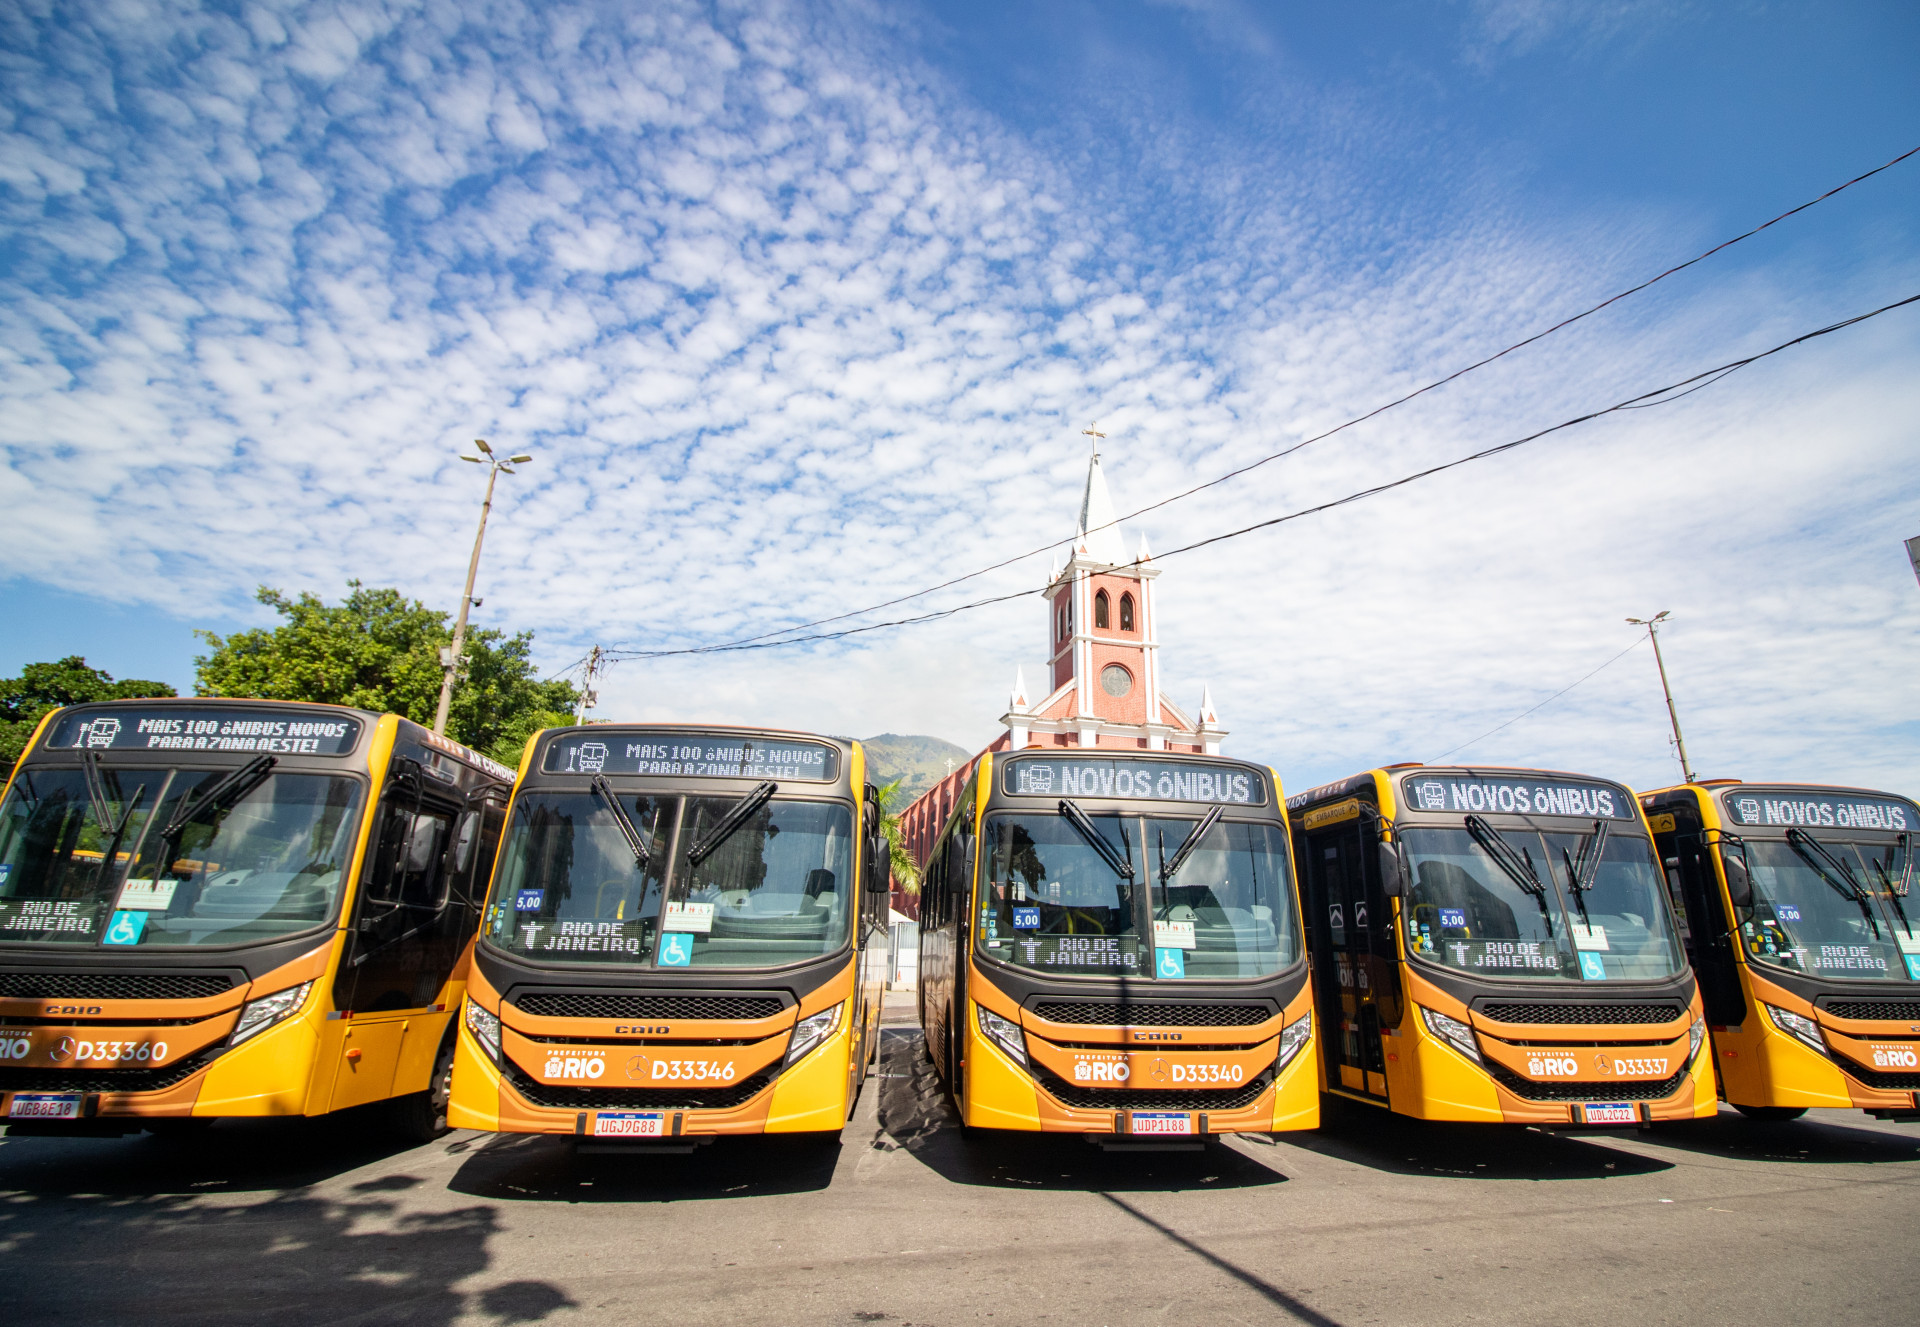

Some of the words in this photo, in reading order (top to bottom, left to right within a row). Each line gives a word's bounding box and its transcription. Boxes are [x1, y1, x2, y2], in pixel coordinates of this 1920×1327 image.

[137, 718, 185, 733] MAIS
[185, 720, 218, 734] 100
[287, 722, 348, 737] NOVOS
[626, 743, 667, 759] MAIS
[671, 745, 702, 760] 100
[769, 749, 824, 765] NOVOS
[1062, 766, 1151, 798] NOVOS
[1451, 783, 1531, 813] NOVOS
[1316, 807, 1346, 823] EMBARQUE
[1764, 799, 1834, 826] NOVOS
[21, 901, 53, 915] RIO
[53, 901, 81, 916] DE
[517, 896, 541, 909] 5,00
[1014, 914, 1039, 927] 5,00
[1441, 915, 1464, 927] 5,00
[1779, 910, 1800, 920] 5,00
[561, 921, 595, 936] RIO
[597, 922, 625, 937] DE
[1059, 938, 1090, 951] RIO
[1093, 938, 1120, 952] DE
[1485, 941, 1515, 954] RIO
[1517, 942, 1541, 955] DE
[1820, 945, 1848, 957] RIO
[1848, 946, 1871, 957] DE
[45, 1005, 103, 1015] CAIO
[615, 1025, 670, 1034] CAIO
[1133, 1031, 1183, 1041] CAIO
[75, 1041, 168, 1061] D33360
[547, 1049, 606, 1057] PREFEITURA
[1886, 1050, 1918, 1067] RIO
[563, 1057, 606, 1079] RIO
[651, 1060, 735, 1081] D33346
[1092, 1061, 1131, 1081] RIO
[1172, 1064, 1243, 1082] D33340
[1544, 1058, 1579, 1076] RIO
[1614, 1058, 1668, 1076] D33337
[16, 1102, 72, 1116] UGB8E18
[601, 1119, 656, 1133] UGJ9G88
[1137, 1119, 1185, 1132] UDP1I88
